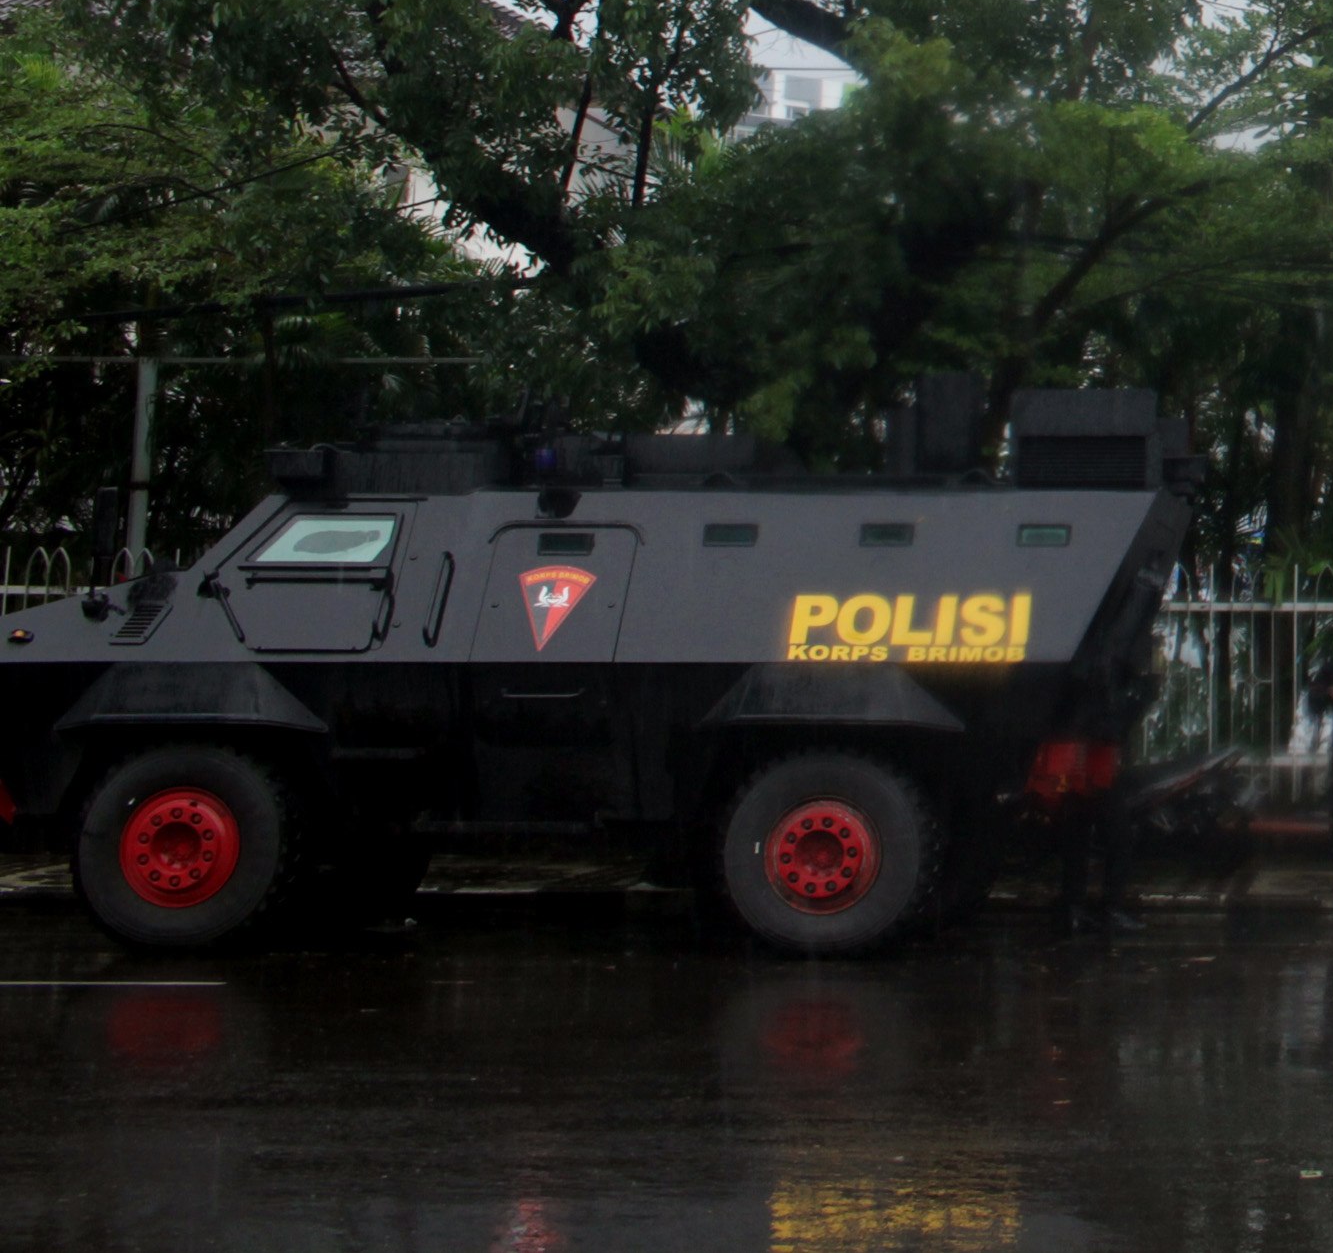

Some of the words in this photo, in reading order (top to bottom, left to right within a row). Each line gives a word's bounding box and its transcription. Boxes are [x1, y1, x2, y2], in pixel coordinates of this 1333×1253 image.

[527, 572, 557, 582] KORPS
[789, 591, 1033, 646] POLISI
[787, 645, 888, 661] KORPS
[906, 645, 1026, 662] BRIMOB
